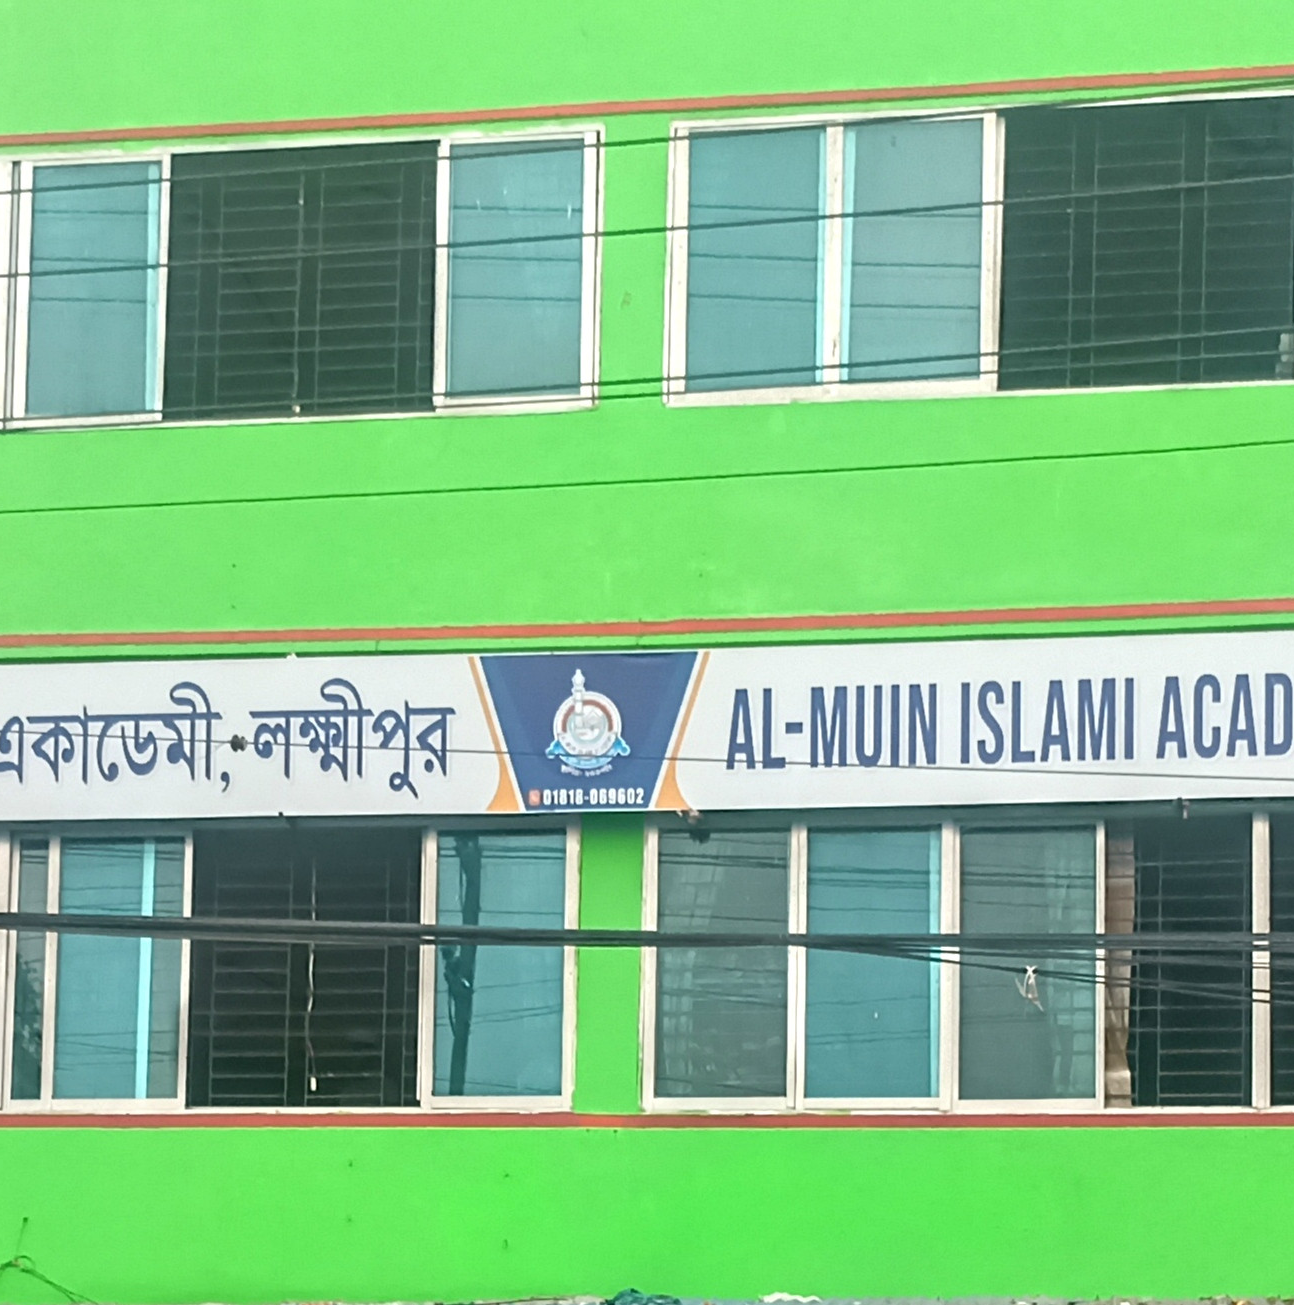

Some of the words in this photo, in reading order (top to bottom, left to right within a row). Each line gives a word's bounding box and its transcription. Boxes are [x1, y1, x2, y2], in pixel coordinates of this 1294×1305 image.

[249, 678, 456, 799] লক্ষ্মীপুর
[726, 682, 937, 770] AL-MUIN
[960, 677, 1135, 764] ISLAMI
